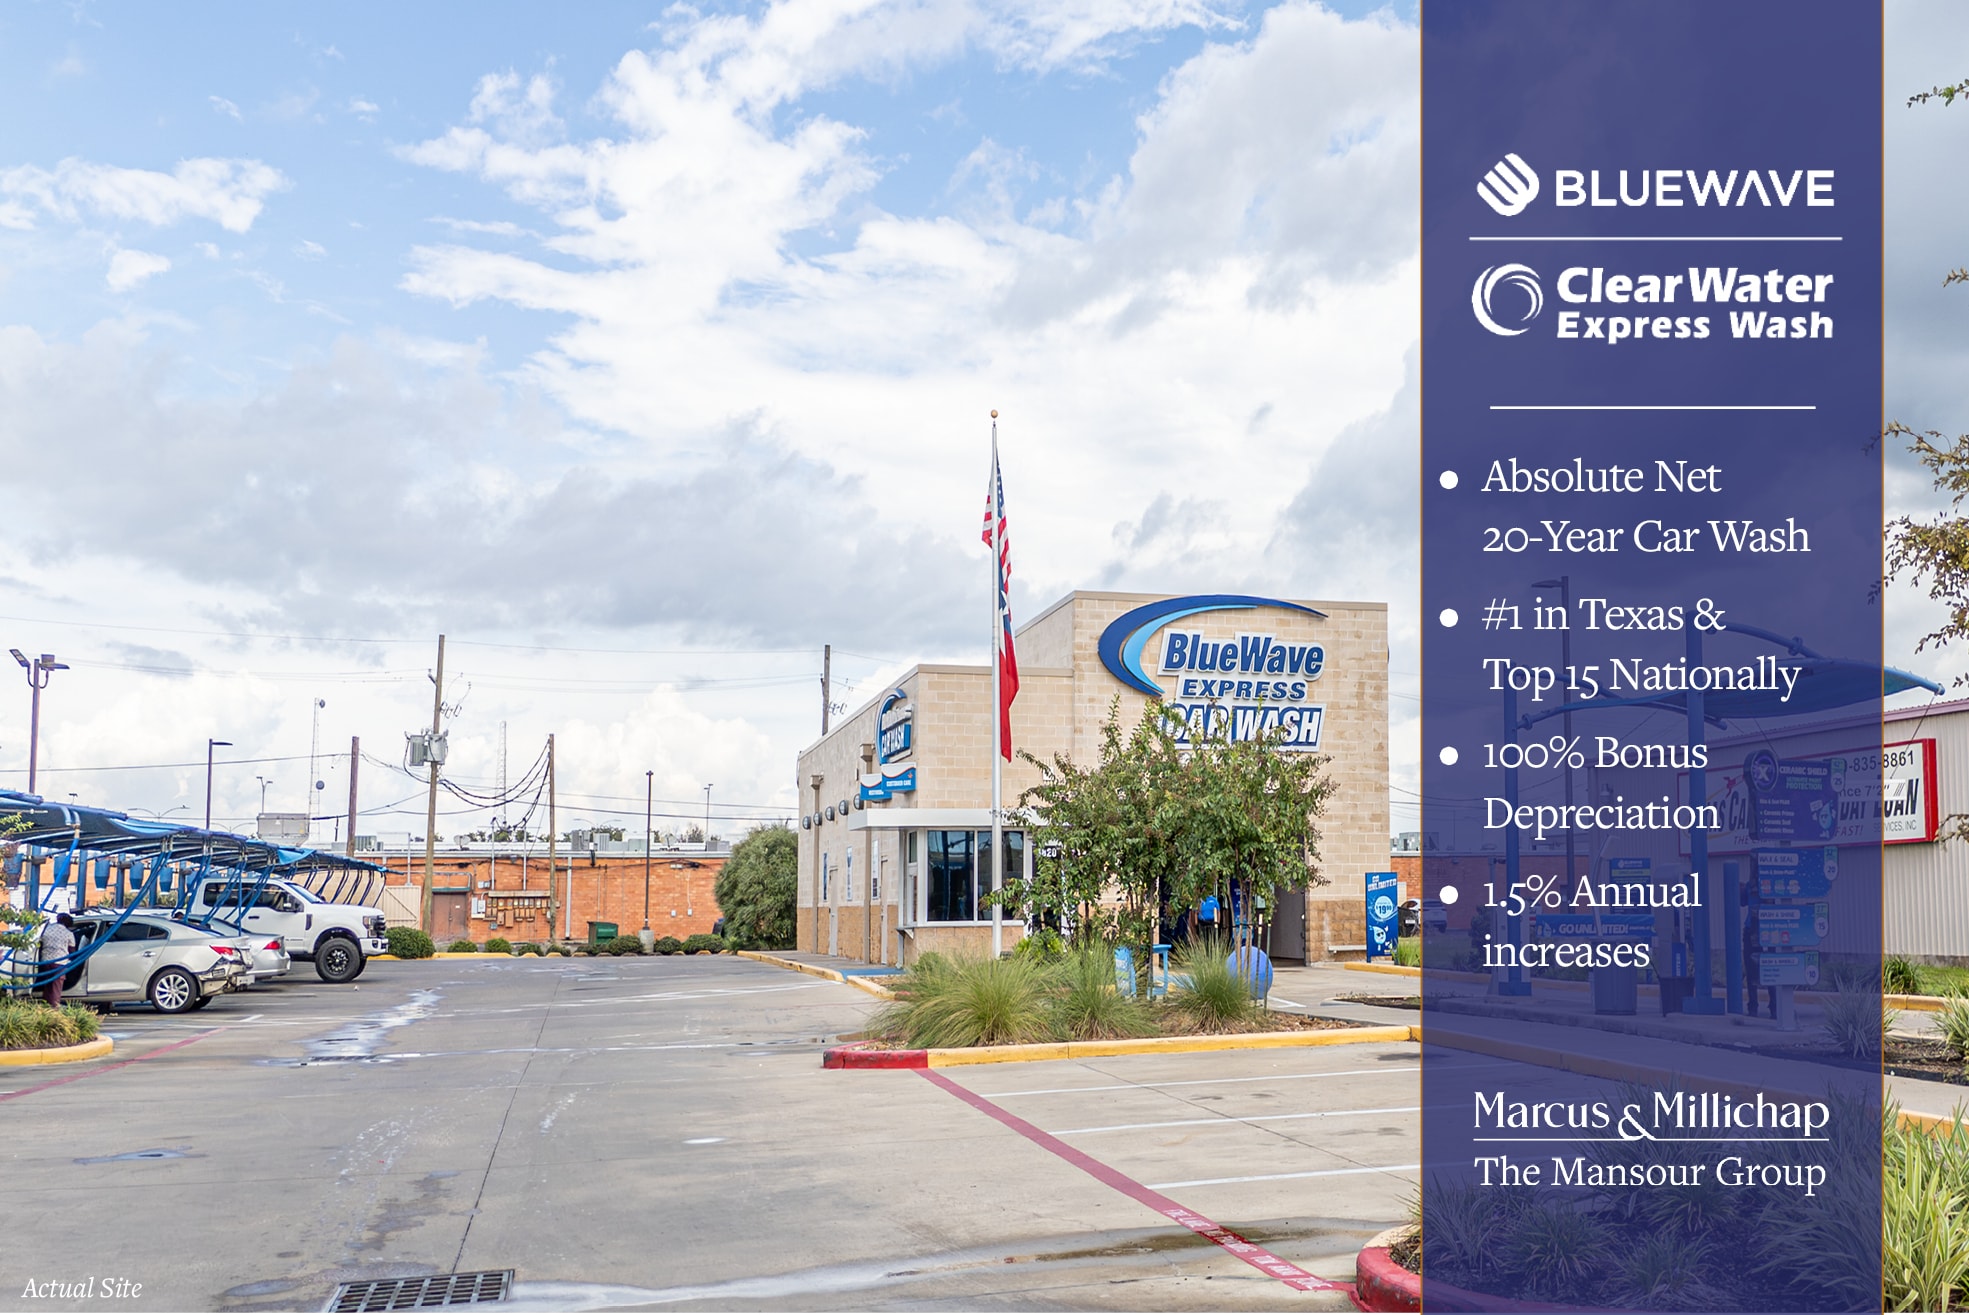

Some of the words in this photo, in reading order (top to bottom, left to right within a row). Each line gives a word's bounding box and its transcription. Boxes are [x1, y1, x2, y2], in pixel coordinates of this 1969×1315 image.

[1163, 632, 1325, 676] BlueWave
[1182, 678, 1307, 700] EXPRESS
[1234, 706, 1322, 744] WASH
[1558, 923, 1575, 934] GO
